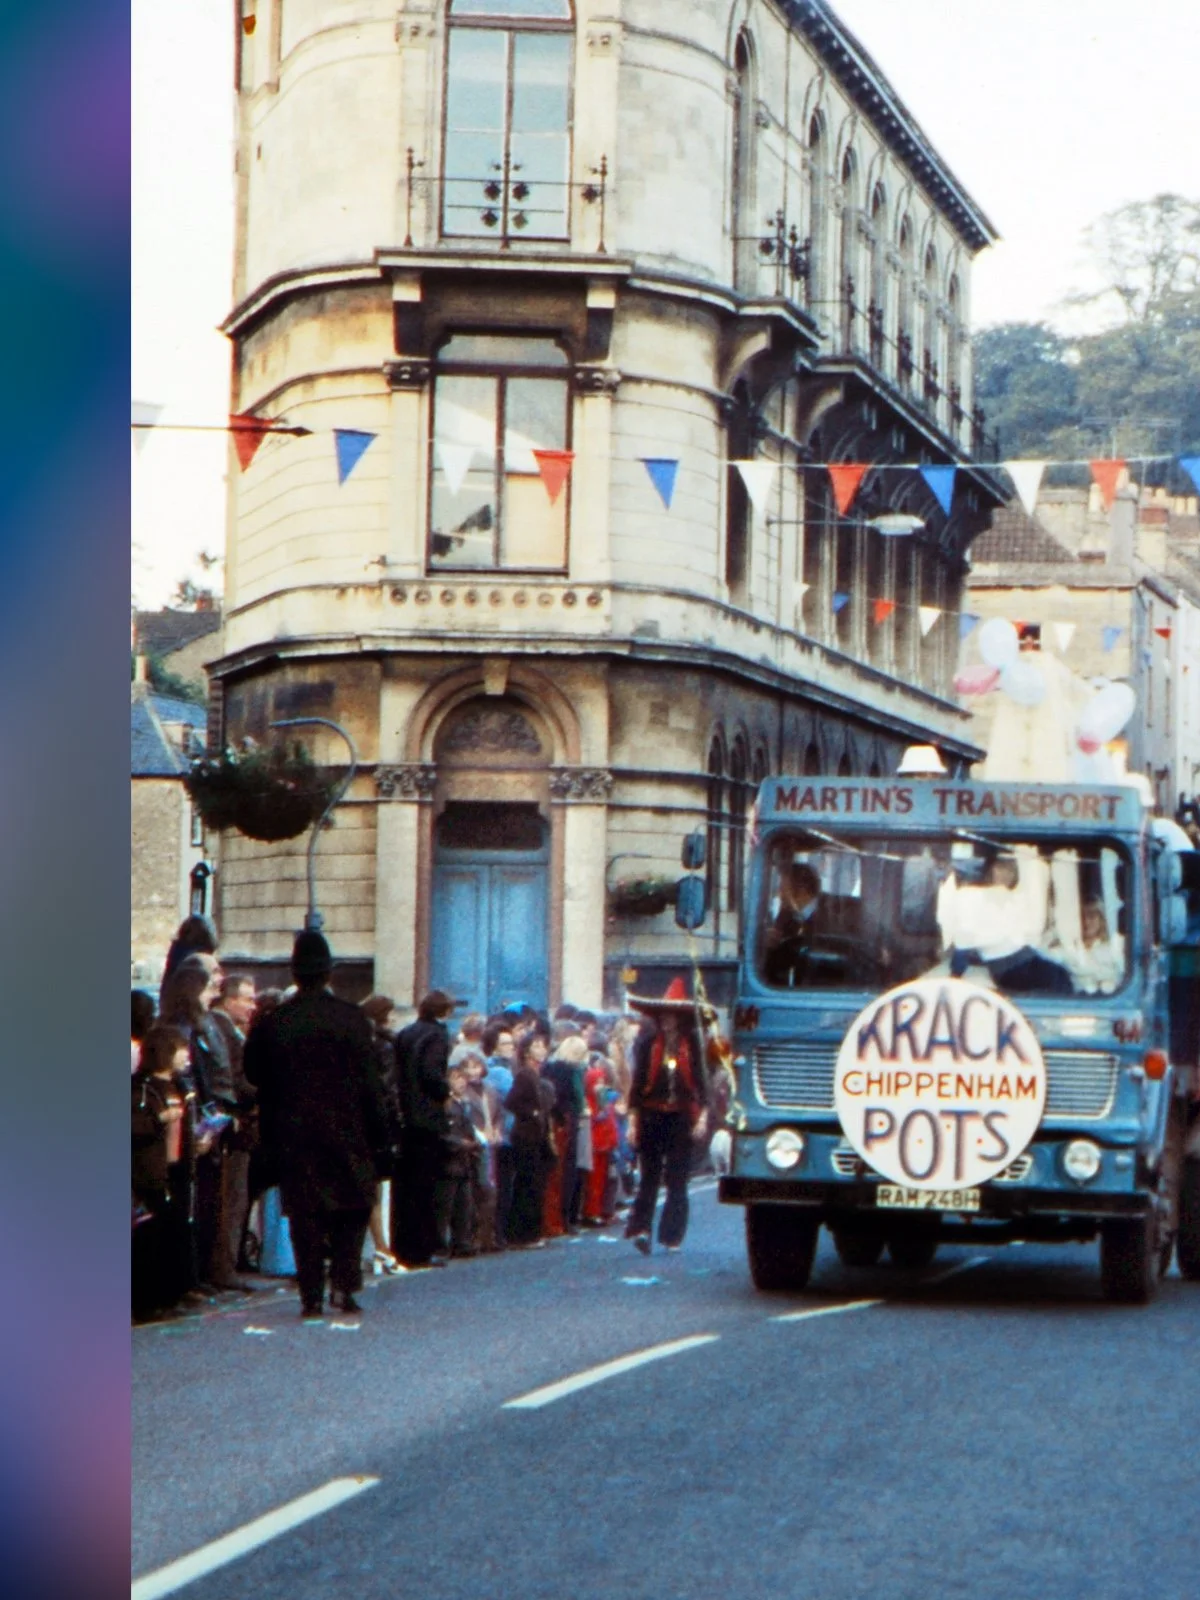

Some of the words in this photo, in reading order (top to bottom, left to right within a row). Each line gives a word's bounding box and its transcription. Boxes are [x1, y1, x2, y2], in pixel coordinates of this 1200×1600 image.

[775, 785, 914, 814] MARTIN'S
[933, 787, 1124, 821] TRANSPORT
[857, 986, 1031, 1065] KRACK
[842, 1070, 1037, 1100] CHIPPENHAM
[863, 1107, 1011, 1182] POTS
[880, 1187, 919, 1206] RAM
